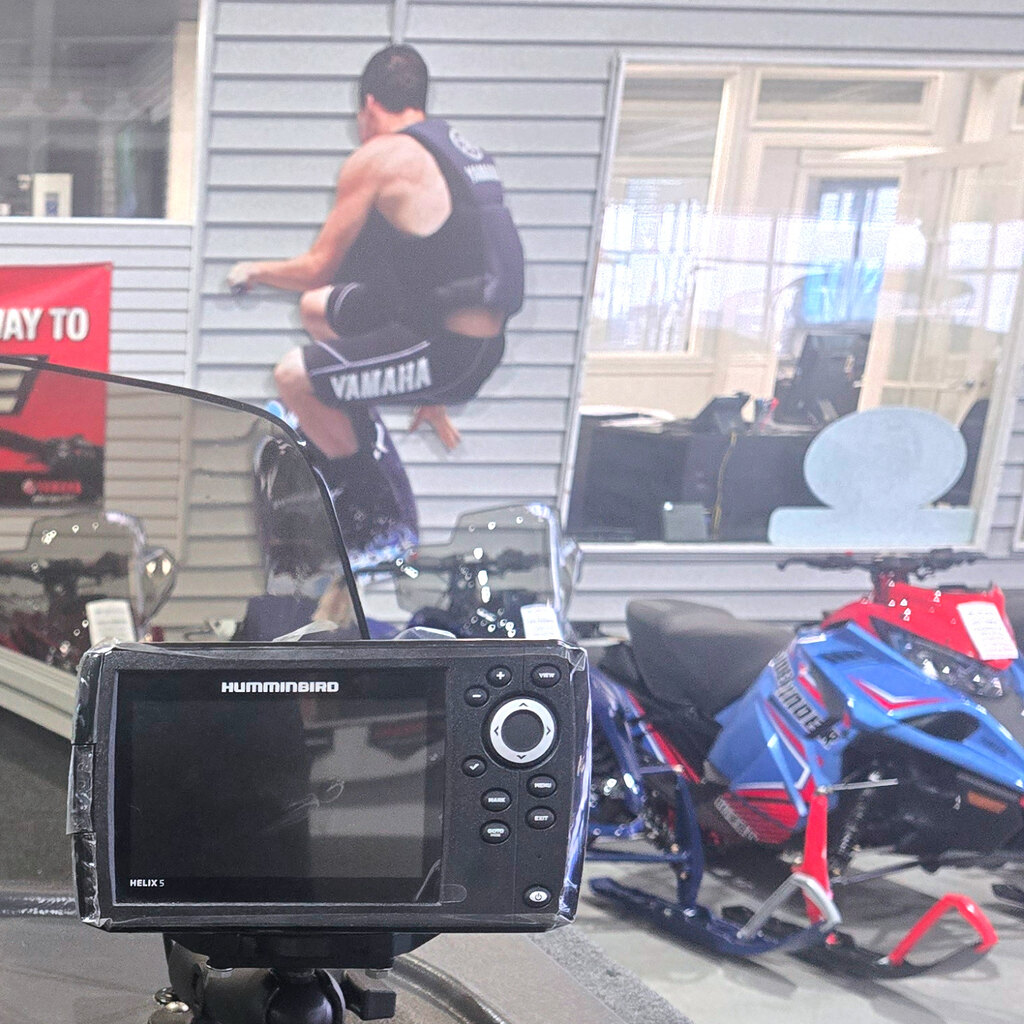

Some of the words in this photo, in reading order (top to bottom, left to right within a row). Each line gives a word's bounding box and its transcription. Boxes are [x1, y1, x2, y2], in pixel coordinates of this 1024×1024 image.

[48, 306, 90, 341] TO
[330, 356, 432, 400] YAMAHA
[221, 681, 339, 693] HUMMINBIRD
[129, 879, 158, 887] HELIX
[159, 879, 165, 887] 5
